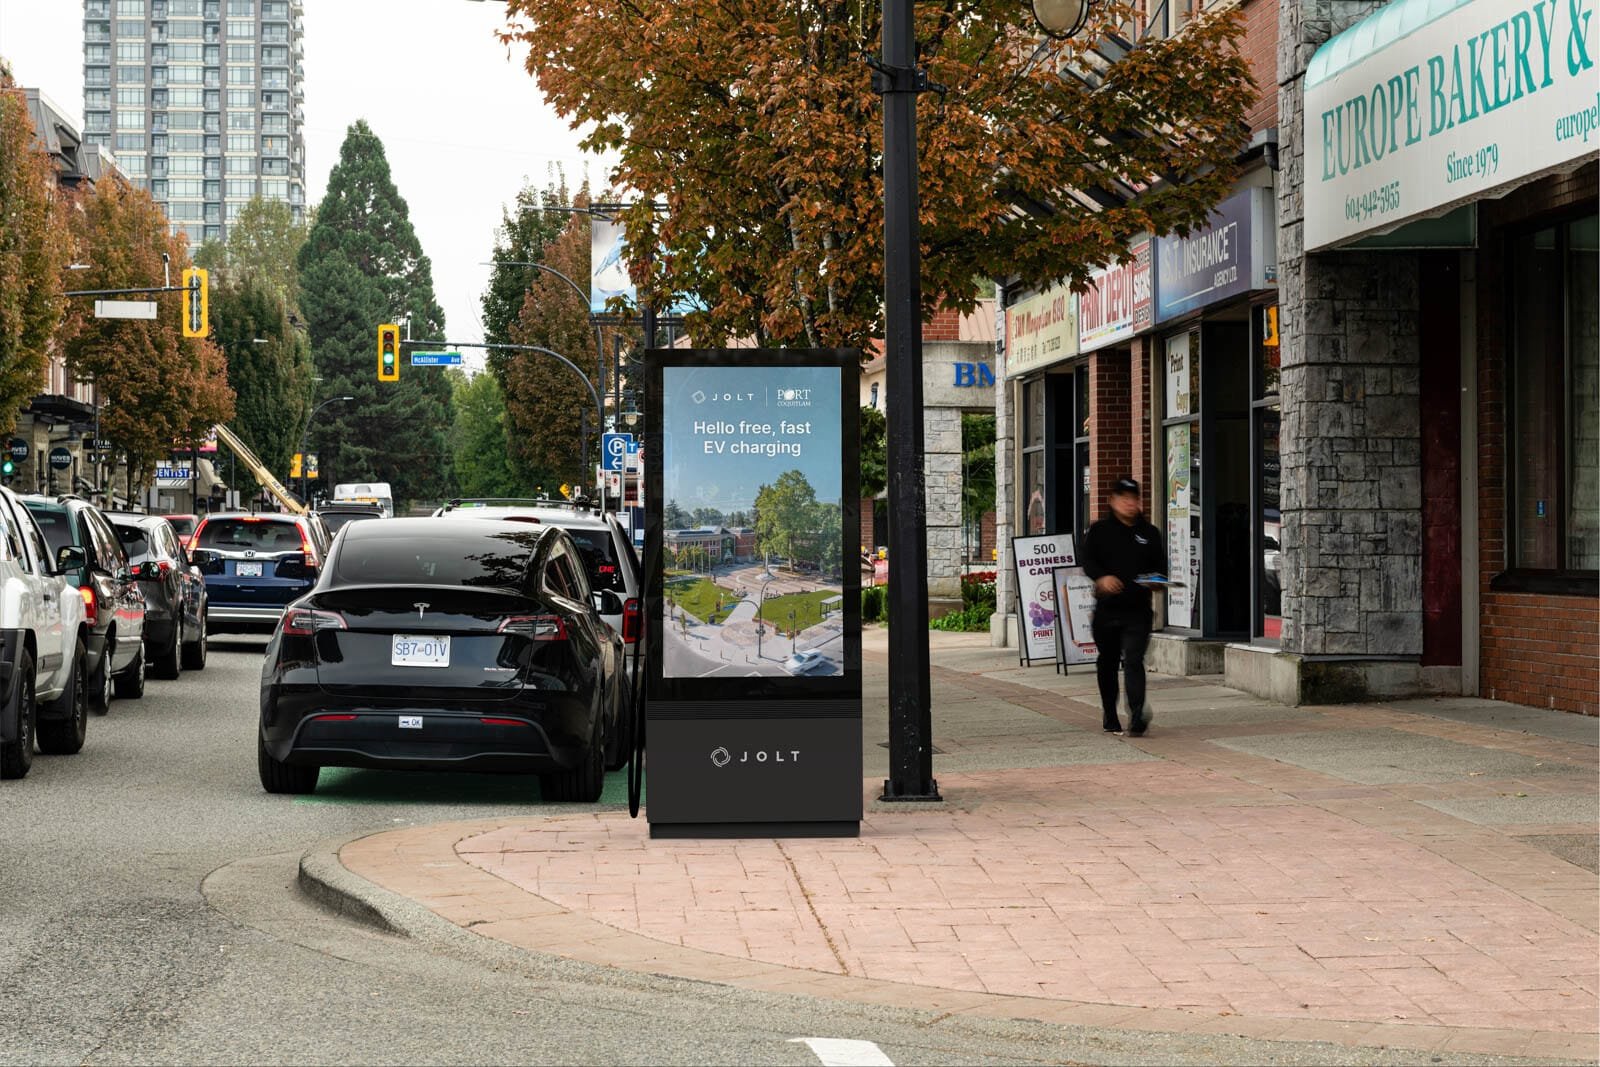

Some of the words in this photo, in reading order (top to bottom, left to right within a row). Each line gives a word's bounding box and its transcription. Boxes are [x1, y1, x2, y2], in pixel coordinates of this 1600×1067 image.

[1322, 65, 1421, 182] EUROPE
[1427, 0, 1556, 137] BAKERY
[1567, 0, 1593, 77] &
[1447, 152, 1474, 184] Since
[1475, 143, 1499, 178] 1979
[1345, 180, 1400, 222] 604-942-5955
[1183, 226, 1229, 277] INSURANCE
[1081, 276, 1105, 333] PRINT
[1106, 260, 1132, 324] DEPOT
[712, 393, 754, 401] JOLT
[694, 421, 735, 434] Hello
[739, 421, 776, 436] free,
[780, 421, 811, 434] fast
[704, 440, 725, 454] EV
[730, 440, 801, 457] charging
[1033, 543, 1056, 555] 500
[1019, 555, 1073, 567] BUSINESS
[1033, 629, 1053, 638] PRINT
[395, 643, 418, 656] SB7
[740, 751, 800, 762] JOLT
